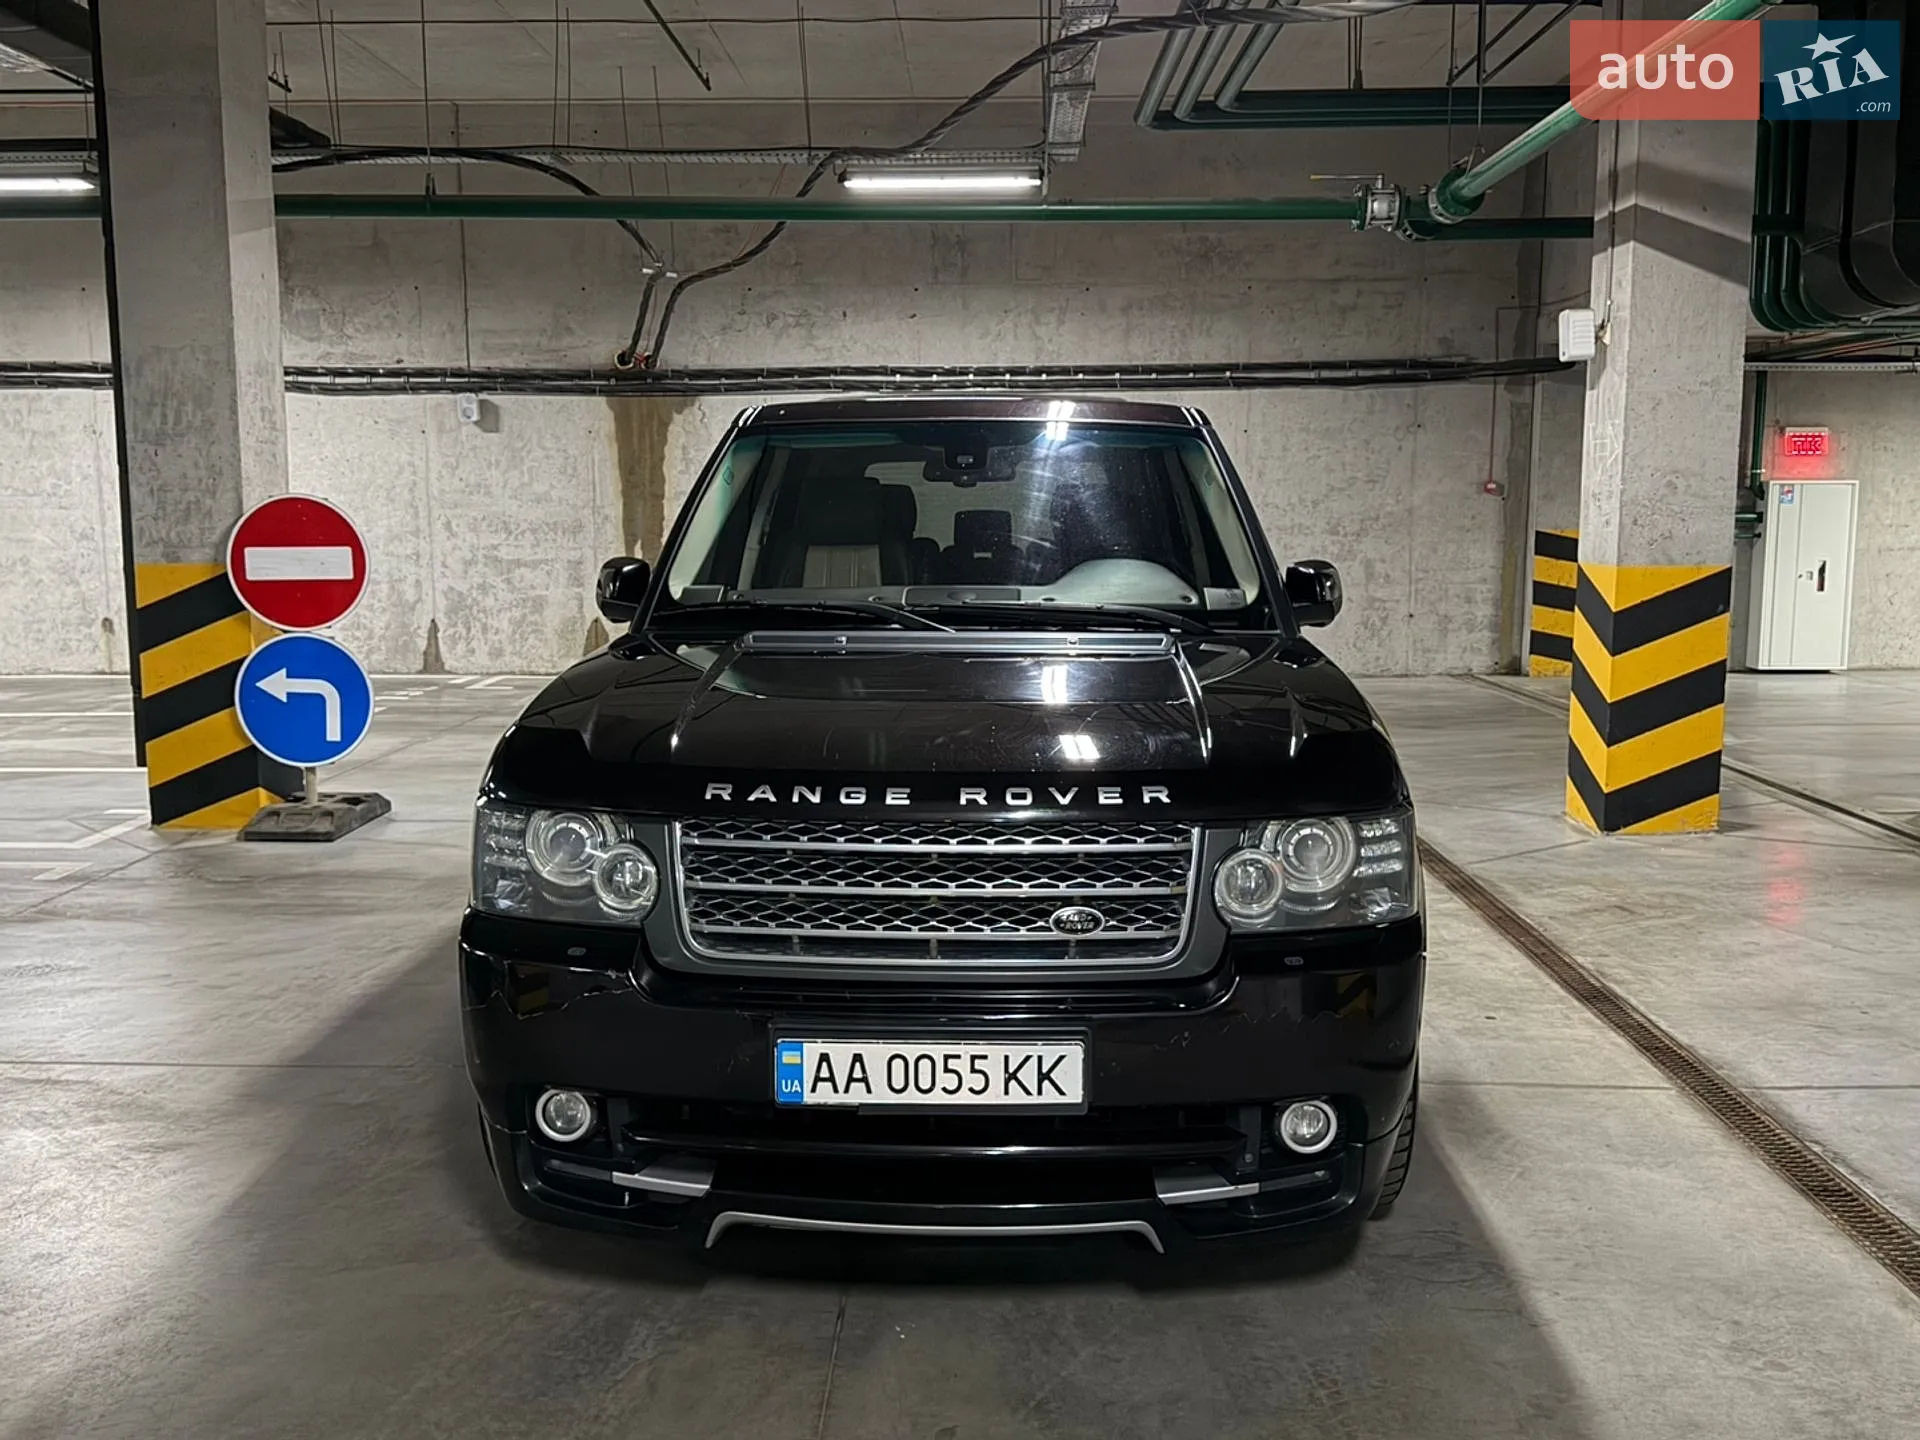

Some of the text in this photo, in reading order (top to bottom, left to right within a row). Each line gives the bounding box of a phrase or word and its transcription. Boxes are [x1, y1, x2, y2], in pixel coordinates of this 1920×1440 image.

[704, 782, 1171, 806] RANGE ROVER
[1065, 921, 1095, 930] ROVER
[810, 1052, 1068, 1097] AA 0055 KK
[781, 1079, 802, 1093] UA
